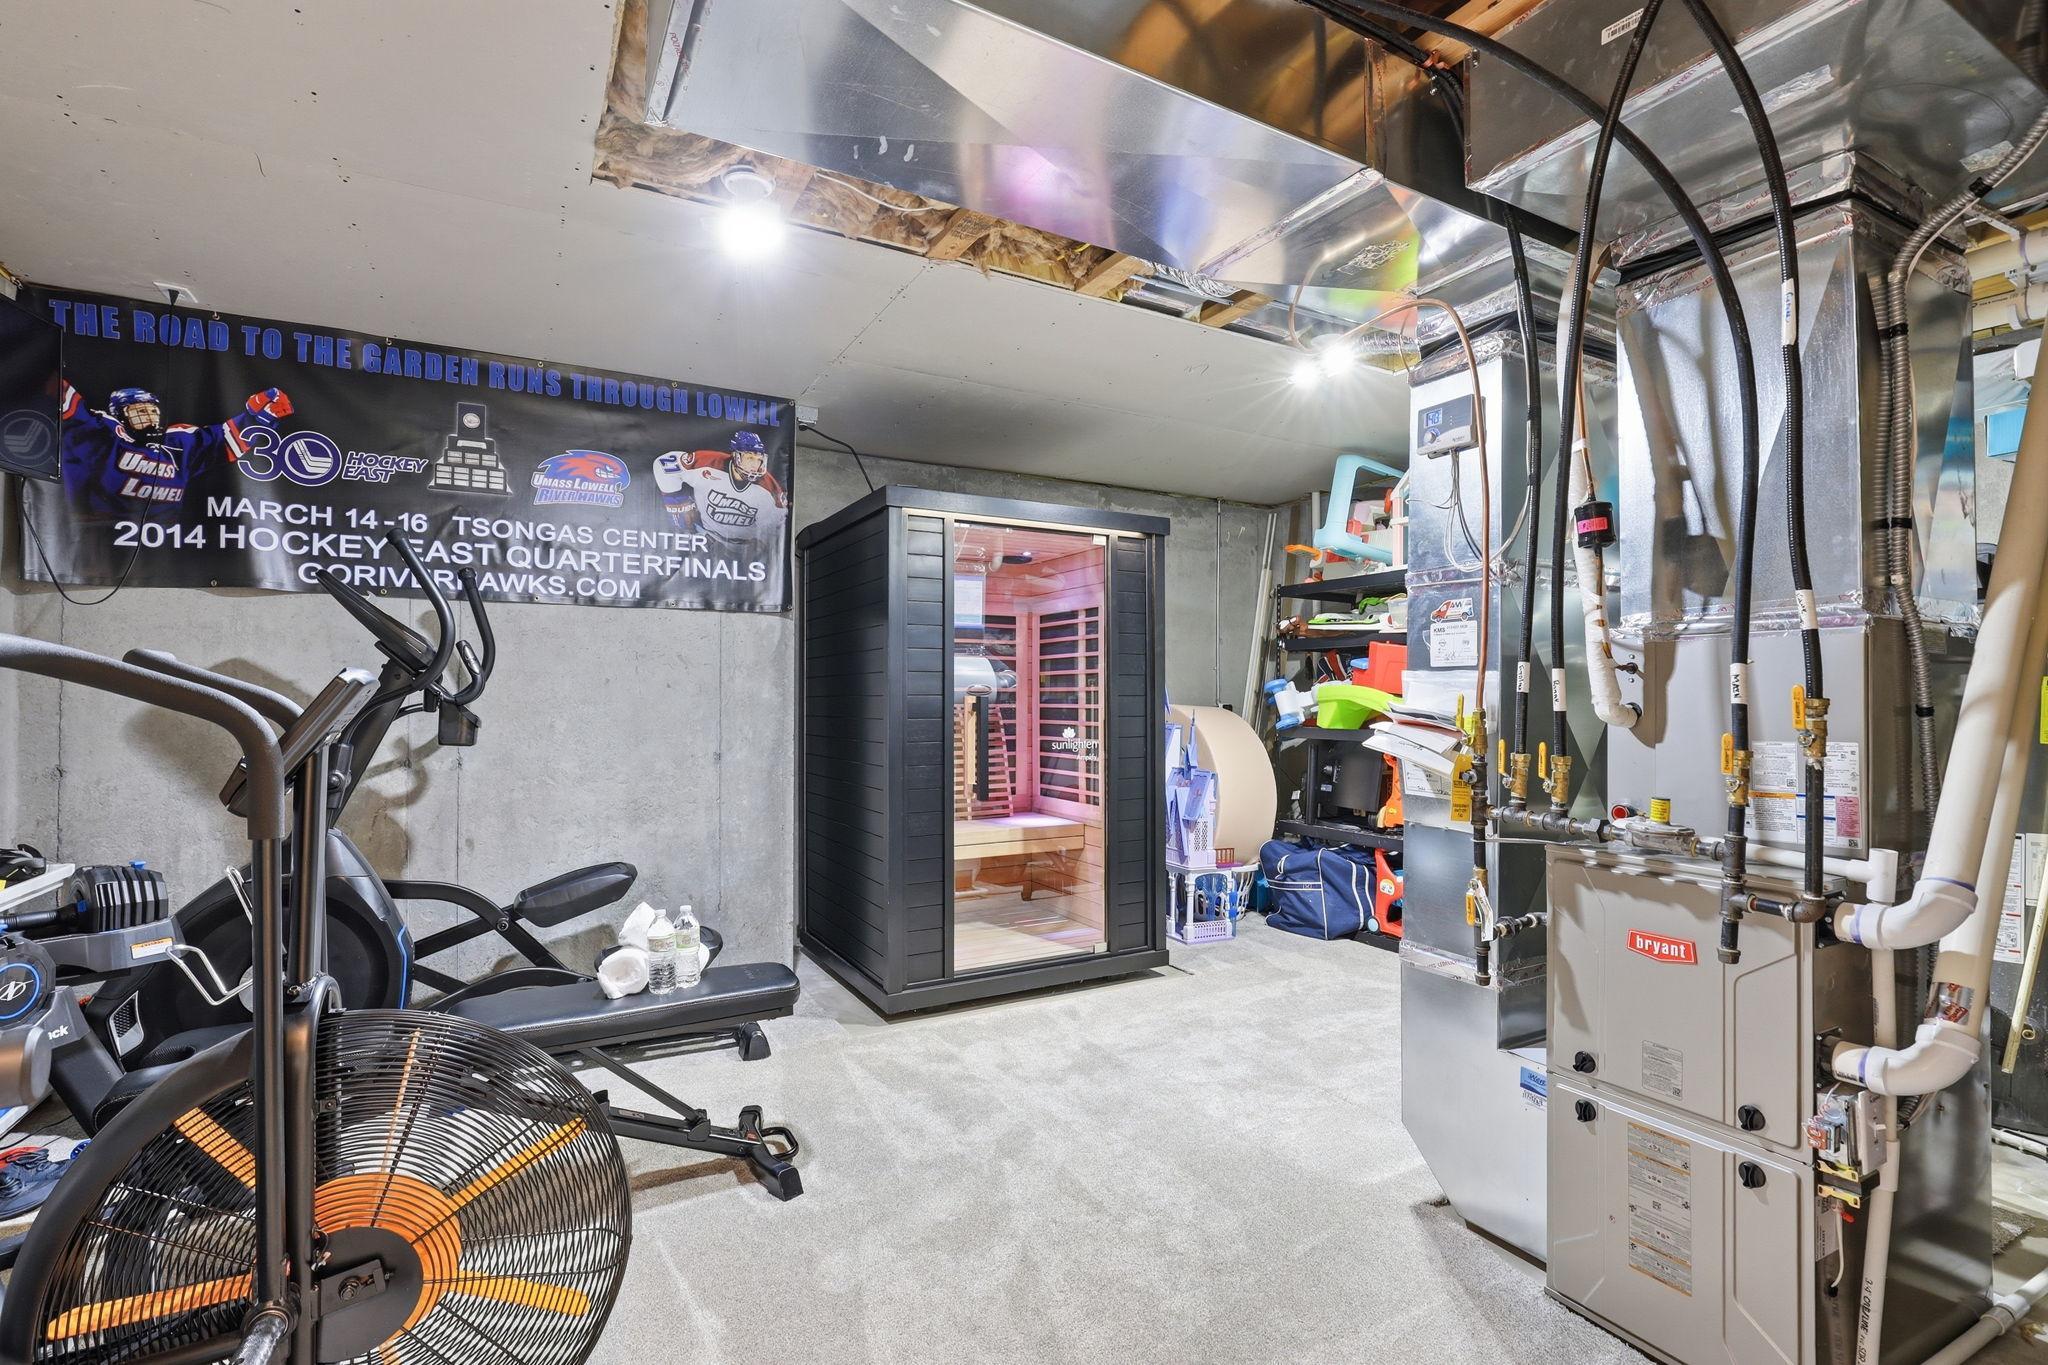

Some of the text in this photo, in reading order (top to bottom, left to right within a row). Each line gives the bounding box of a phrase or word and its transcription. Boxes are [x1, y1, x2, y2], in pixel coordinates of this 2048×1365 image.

[49, 299, 781, 428] THE ROAD TO THE GARDEN RUNS THROUGH LOWELL
[342, 464, 396, 484] EAST
[346, 450, 429, 474] HOCKEY
[533, 474, 616, 493] UMASS LOWELL
[707, 489, 758, 517] UMASS
[207, 496, 333, 527] MARCH
[452, 515, 594, 545] TSONGAS
[602, 528, 709, 554] CENTER
[113, 521, 206, 549] 2014
[219, 524, 389, 560] HOCKEY
[506, 545, 766, 583] QUARTERFINALS
[298, 562, 641, 599] GORIVRAWKS.COM
[1051, 739, 1099, 752] sunlighten
[1636, 934, 1686, 959] bryant
